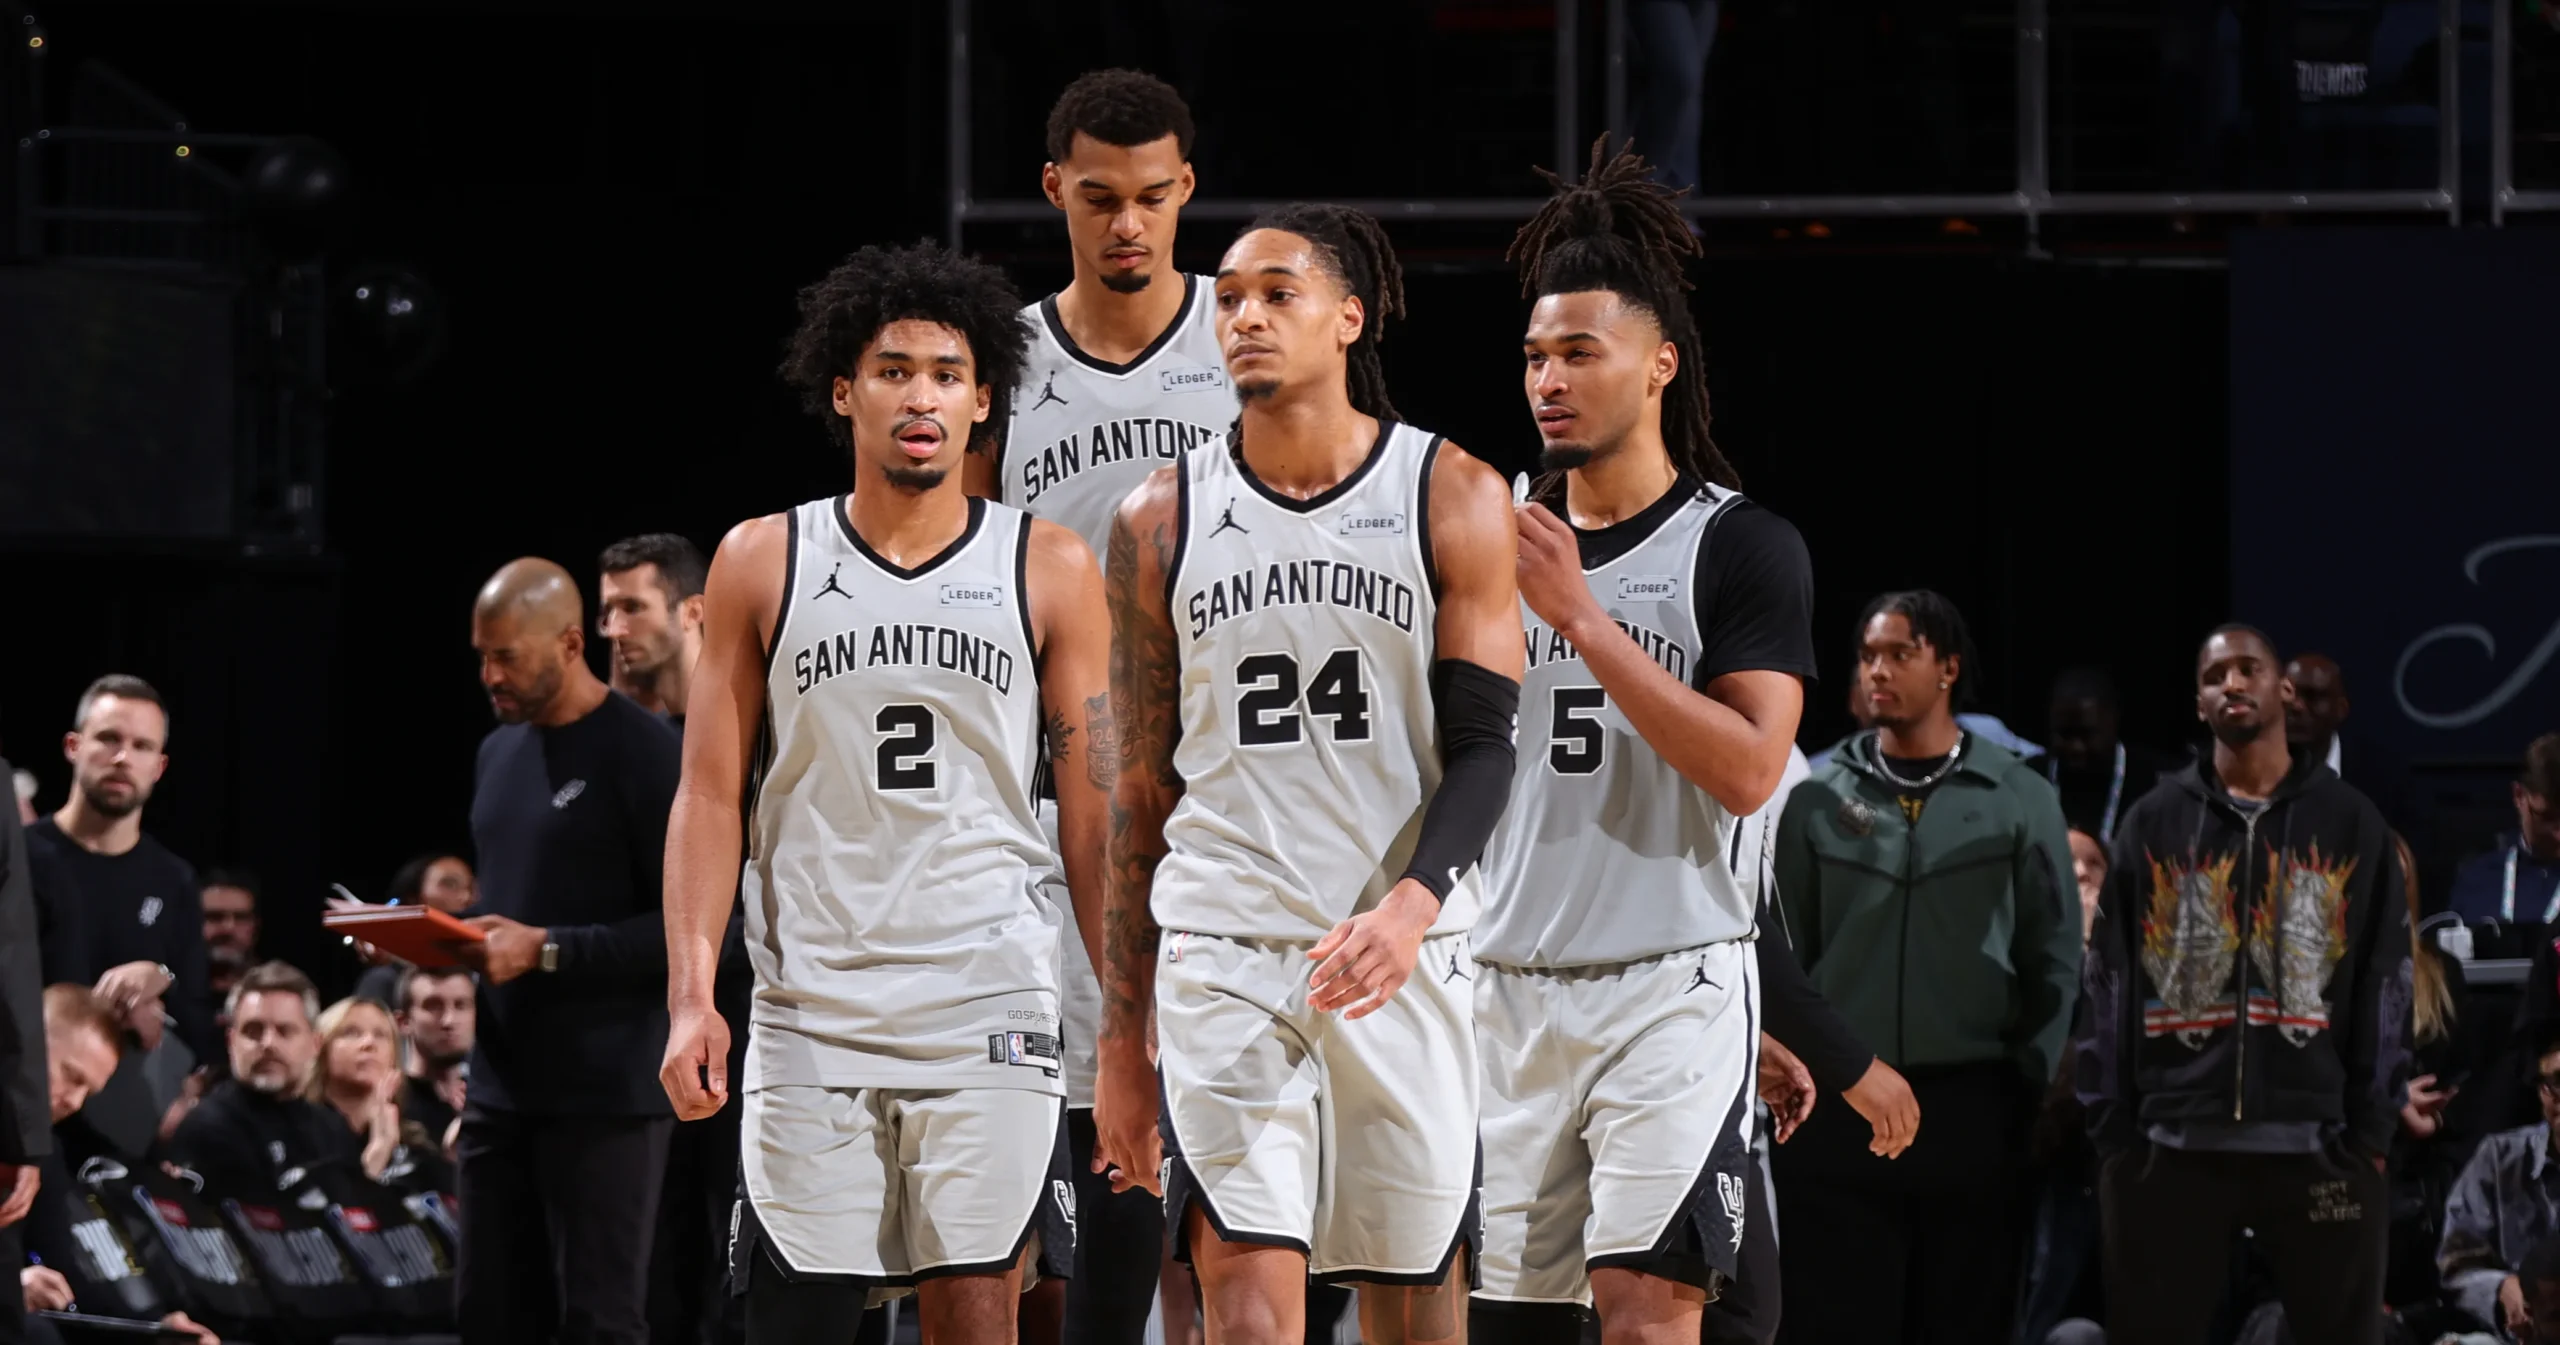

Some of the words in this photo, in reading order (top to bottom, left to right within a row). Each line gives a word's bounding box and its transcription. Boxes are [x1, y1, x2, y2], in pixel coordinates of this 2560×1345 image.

[1169, 372, 1215, 385] LEDGER
[1023, 431, 1082, 505] SAN
[1348, 518, 1395, 529] LEDGER
[948, 590, 995, 601] LEDGER
[1189, 567, 1255, 644] SAN
[1261, 558, 1416, 636] ANTONIO
[1625, 583, 1670, 594] LEDGER
[794, 628, 858, 698] SAN
[865, 622, 1015, 699] ANTONIO
[1234, 647, 1373, 748] 24
[873, 702, 938, 792] 2
[1548, 685, 1608, 776] 5
